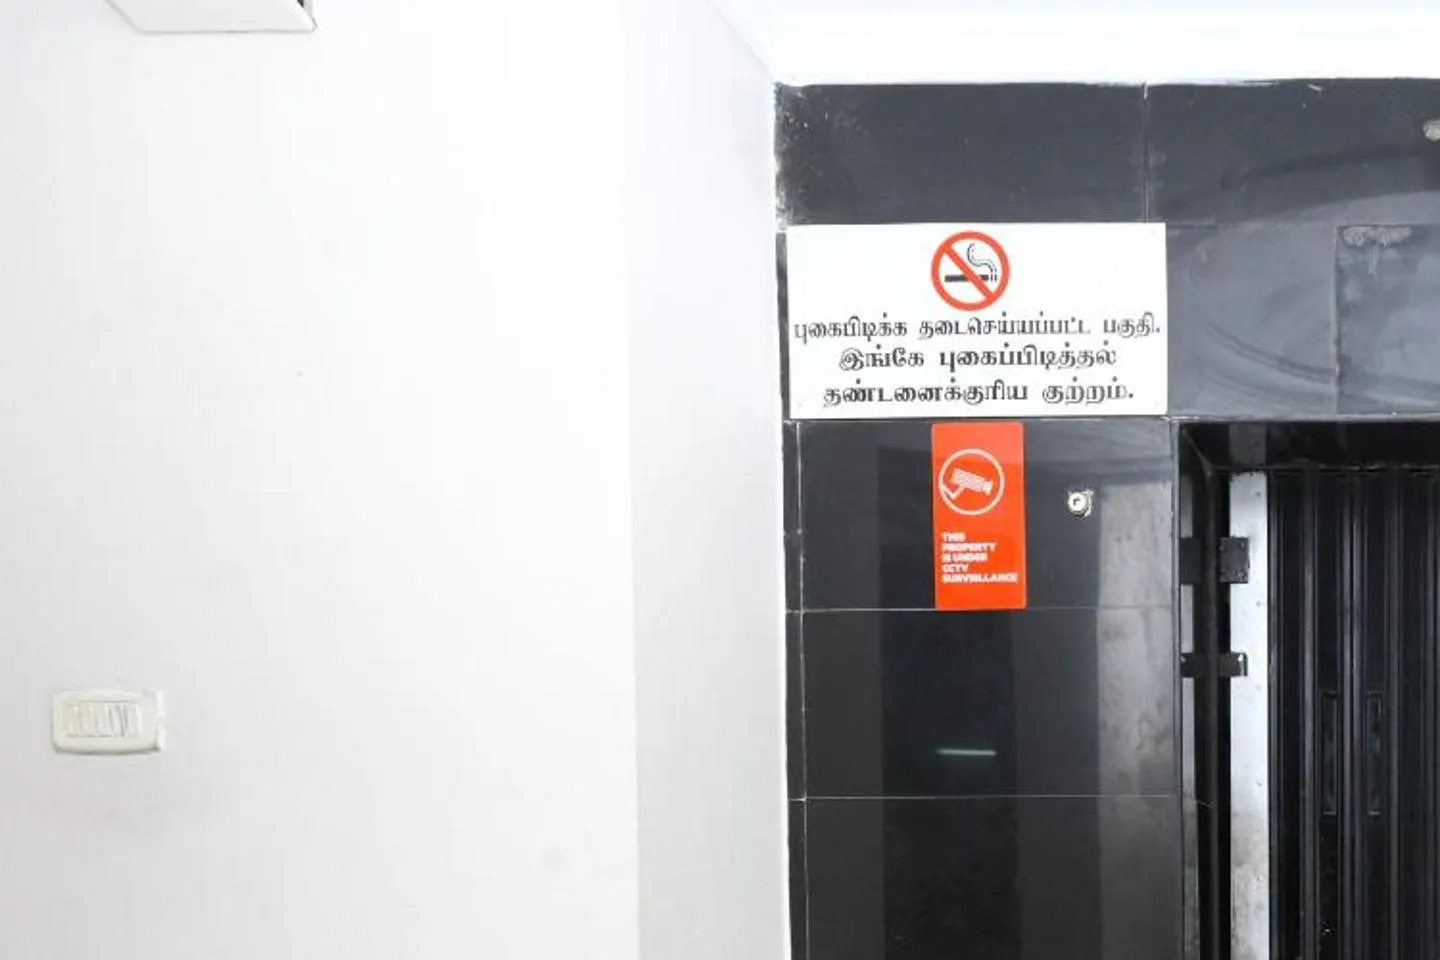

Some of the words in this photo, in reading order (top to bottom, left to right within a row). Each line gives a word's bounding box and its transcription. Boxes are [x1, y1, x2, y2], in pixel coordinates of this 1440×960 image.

[794, 311, 907, 346] புகைபிடிக்க
[917, 310, 1091, 341] தடைசெய்யப்பட்ட
[1103, 311, 1161, 338] பகுதி.
[838, 343, 925, 371] இங்கே
[939, 340, 1117, 373] புகைப்பிடித்தல்
[823, 376, 1028, 408] தண்டனைக்குரிய
[1042, 376, 1134, 405] குற்றம்.
[941, 532, 966, 542] THIS
[942, 542, 997, 552] PROPERTY
[952, 552, 988, 562] UNDER
[942, 563, 969, 573] CCTV
[941, 573, 1018, 583] SURVEILLANCE
